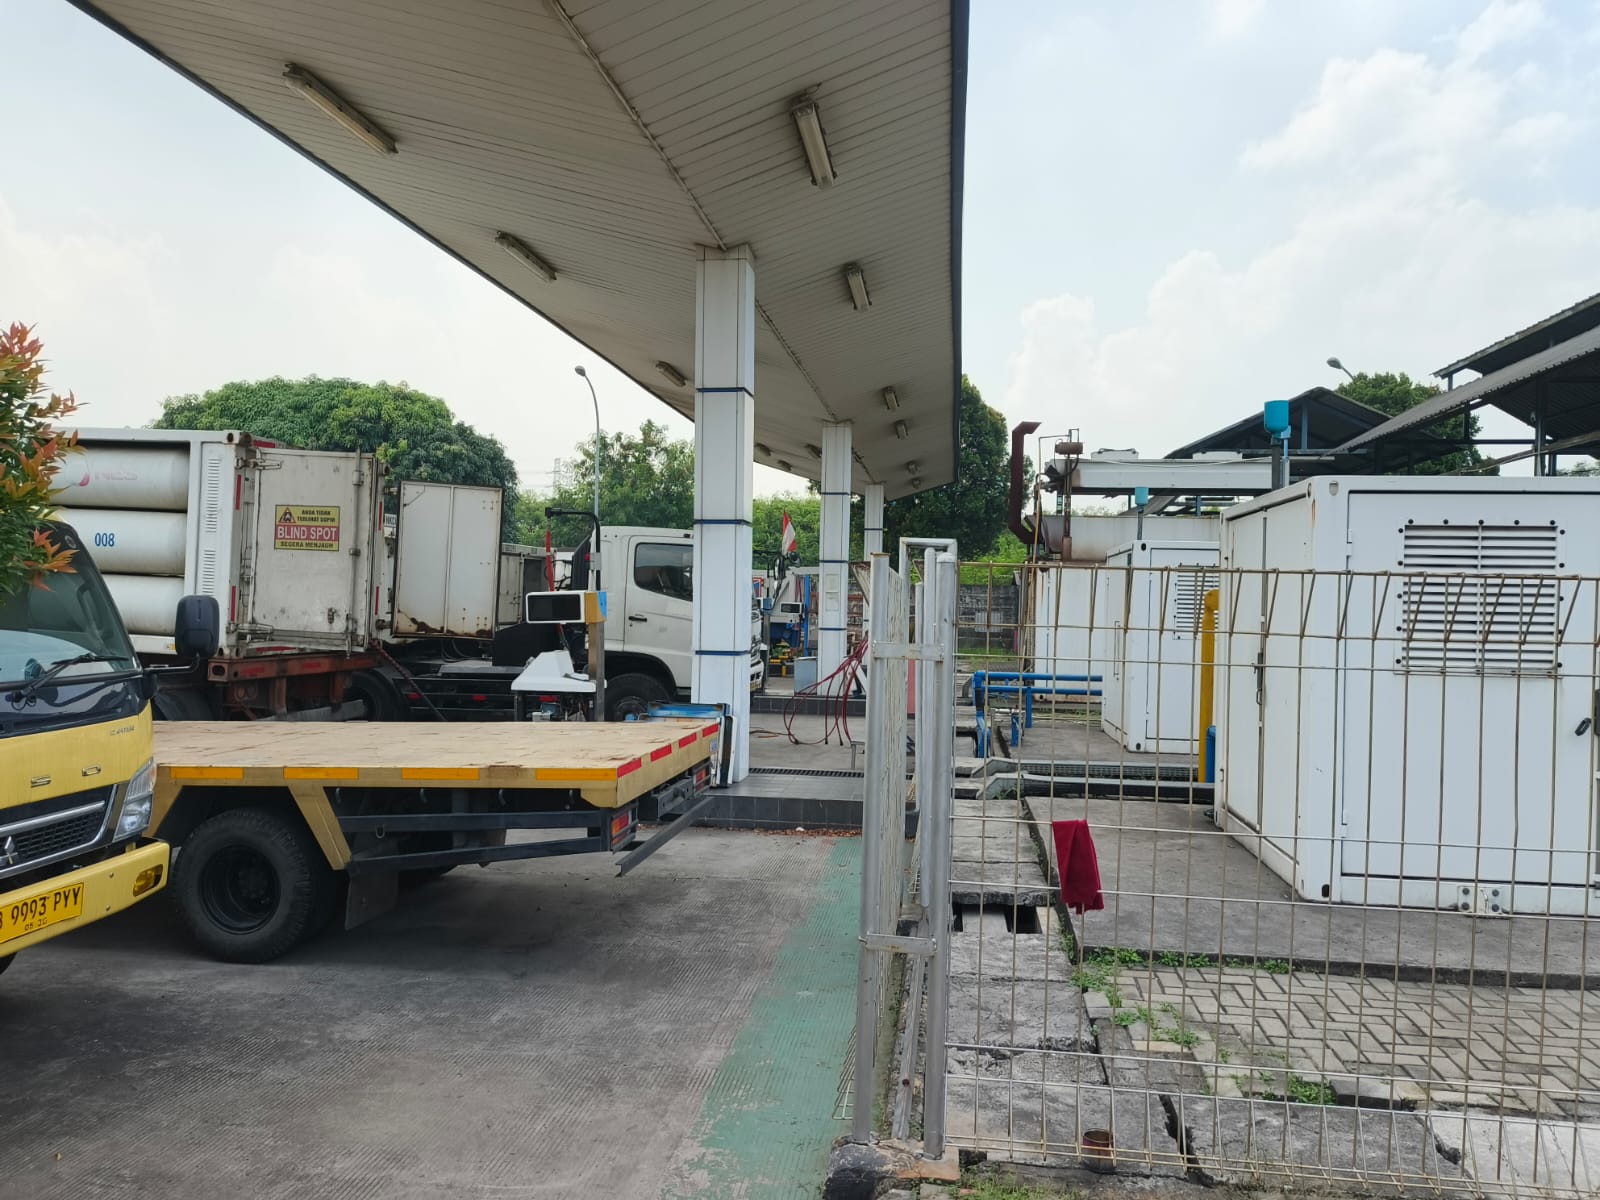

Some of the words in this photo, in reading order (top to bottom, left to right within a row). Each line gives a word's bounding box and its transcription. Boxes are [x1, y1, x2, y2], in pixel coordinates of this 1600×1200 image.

[95, 533, 115, 547] 008
[277, 526, 308, 539] BLIND
[310, 527, 337, 540] SPOT
[11, 895, 47, 926] 9993
[53, 886, 81, 912] PYY
